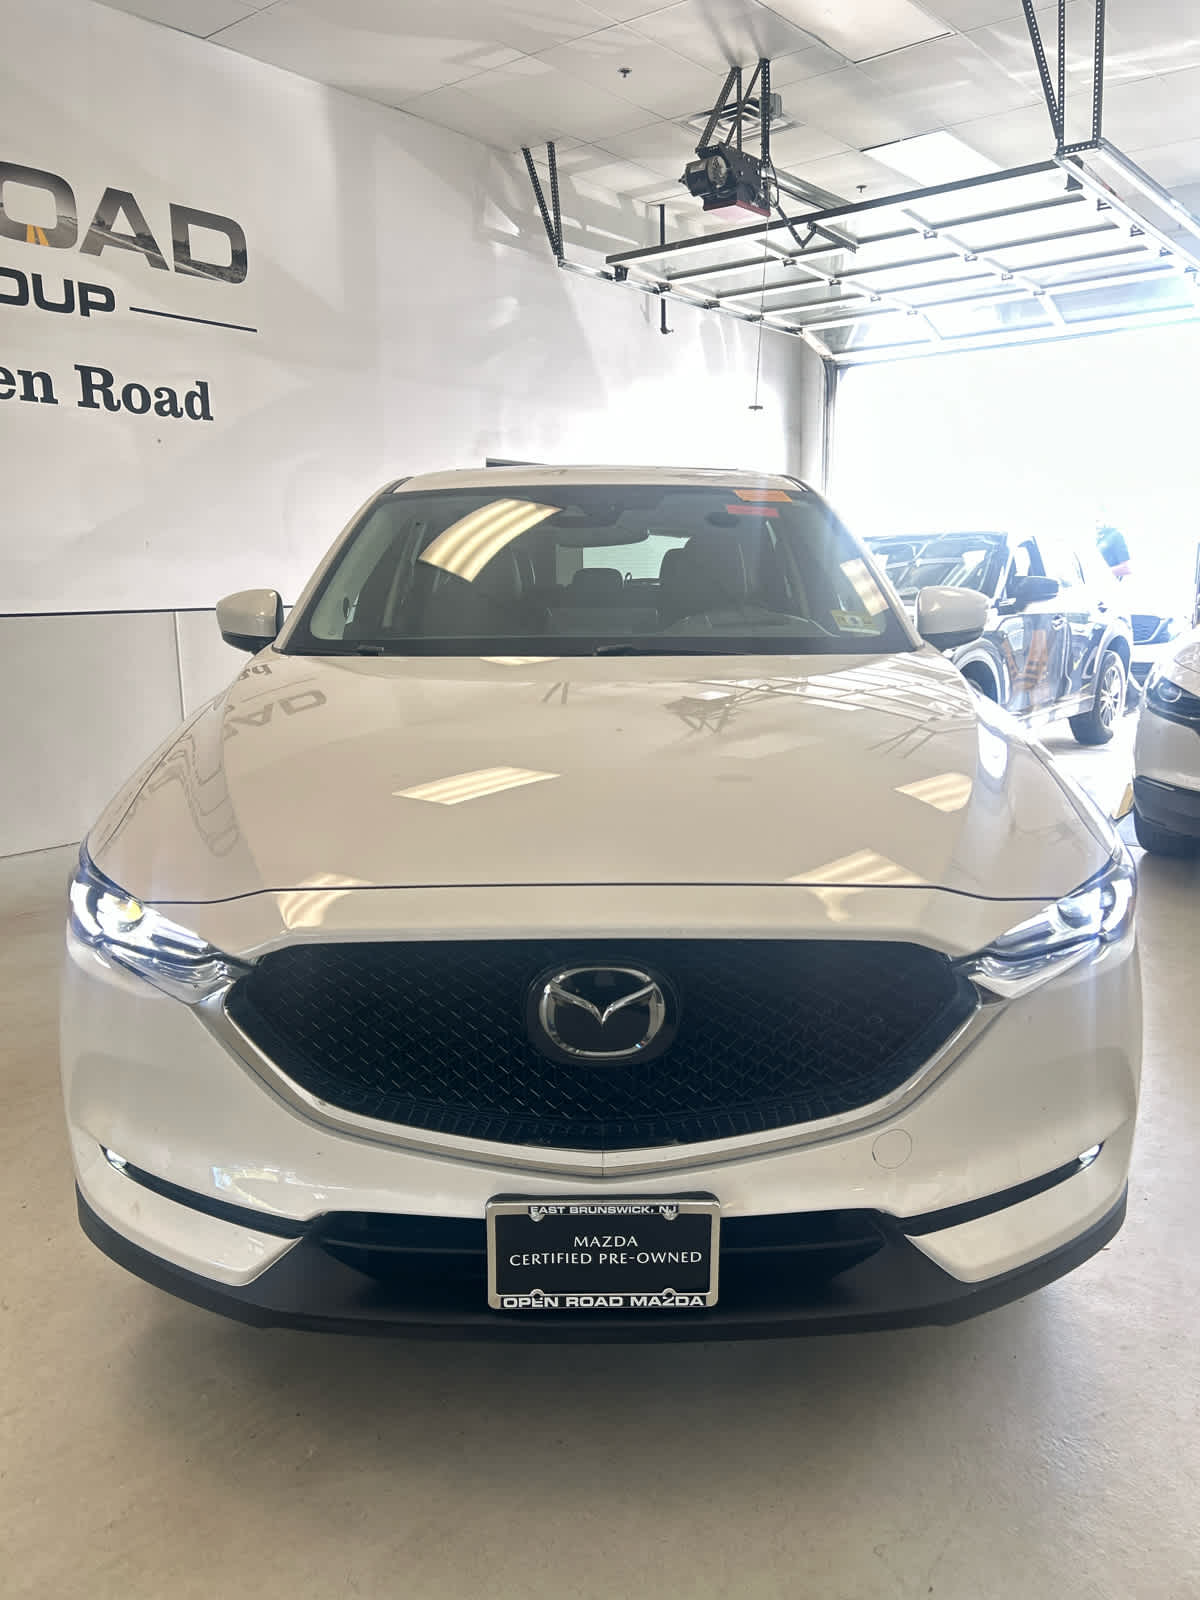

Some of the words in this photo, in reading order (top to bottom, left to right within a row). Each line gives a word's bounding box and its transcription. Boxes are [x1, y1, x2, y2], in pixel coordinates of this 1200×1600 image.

[74, 363, 214, 421] Road
[530, 1205, 566, 1215] EAST
[659, 1204, 678, 1215] NJ
[573, 1235, 639, 1248] MAZDA
[509, 1252, 592, 1267] CERTIFIED
[599, 1251, 702, 1265] PRE-OWNED
[503, 1296, 559, 1308] OPEN
[565, 1296, 623, 1308] ROAD
[630, 1295, 705, 1307] MAZDA
